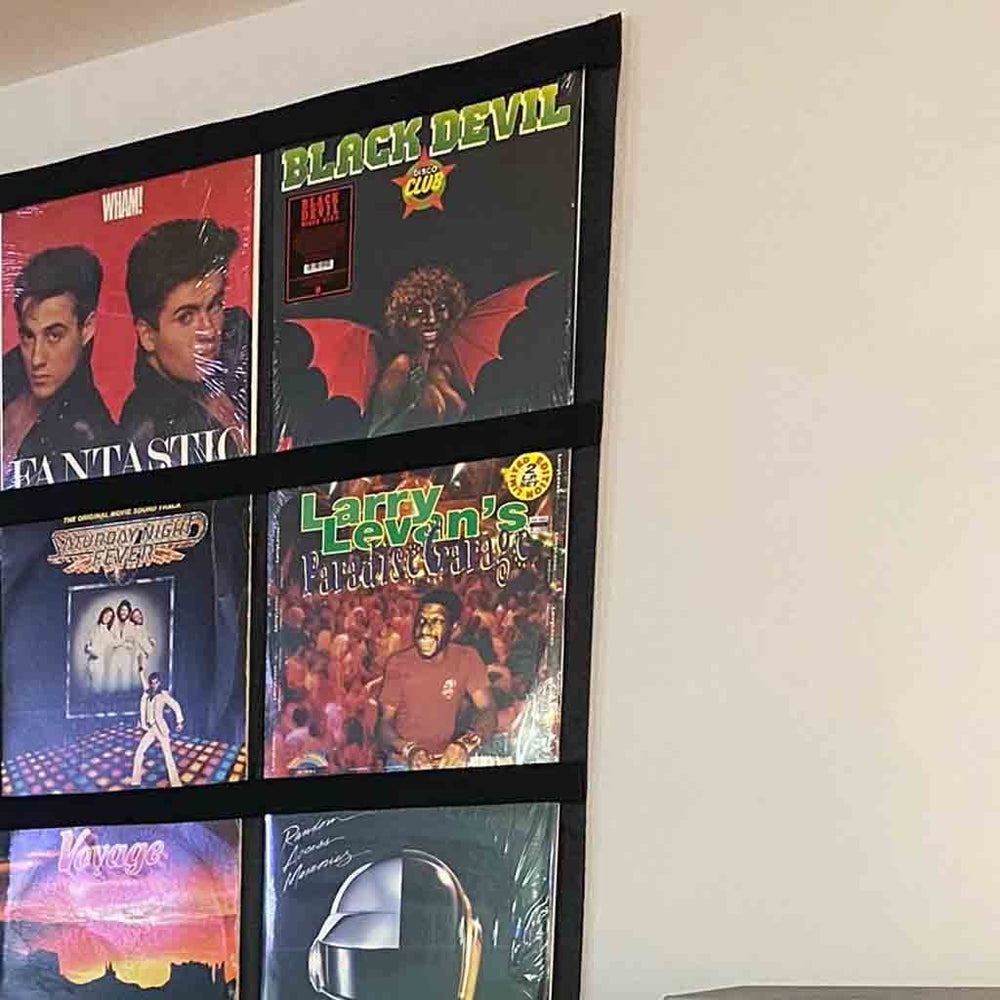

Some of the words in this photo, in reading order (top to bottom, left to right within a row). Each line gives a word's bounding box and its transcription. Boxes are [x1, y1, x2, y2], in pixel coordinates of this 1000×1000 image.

[281, 117, 423, 193] BLACK
[429, 83, 571, 157] DEVIL
[404, 171, 444, 196] CLUB
[413, 164, 438, 177] DISCO
[101, 186, 143, 222] WHAM!
[10, 425, 247, 490] FANTASTIC
[508, 457, 530, 496] LIMITED
[524, 463, 537, 474] 2
[525, 456, 551, 499] EDITION
[63, 516, 77, 524] THE
[301, 485, 444, 533] Larry
[321, 495, 529, 556] Levan's
[53, 526, 138, 551] SATURDAY
[93, 545, 154, 567] FEVER
[302, 540, 420, 599] Paradise
[424, 522, 530, 588] Garage
[57, 829, 167, 876] Voyage
